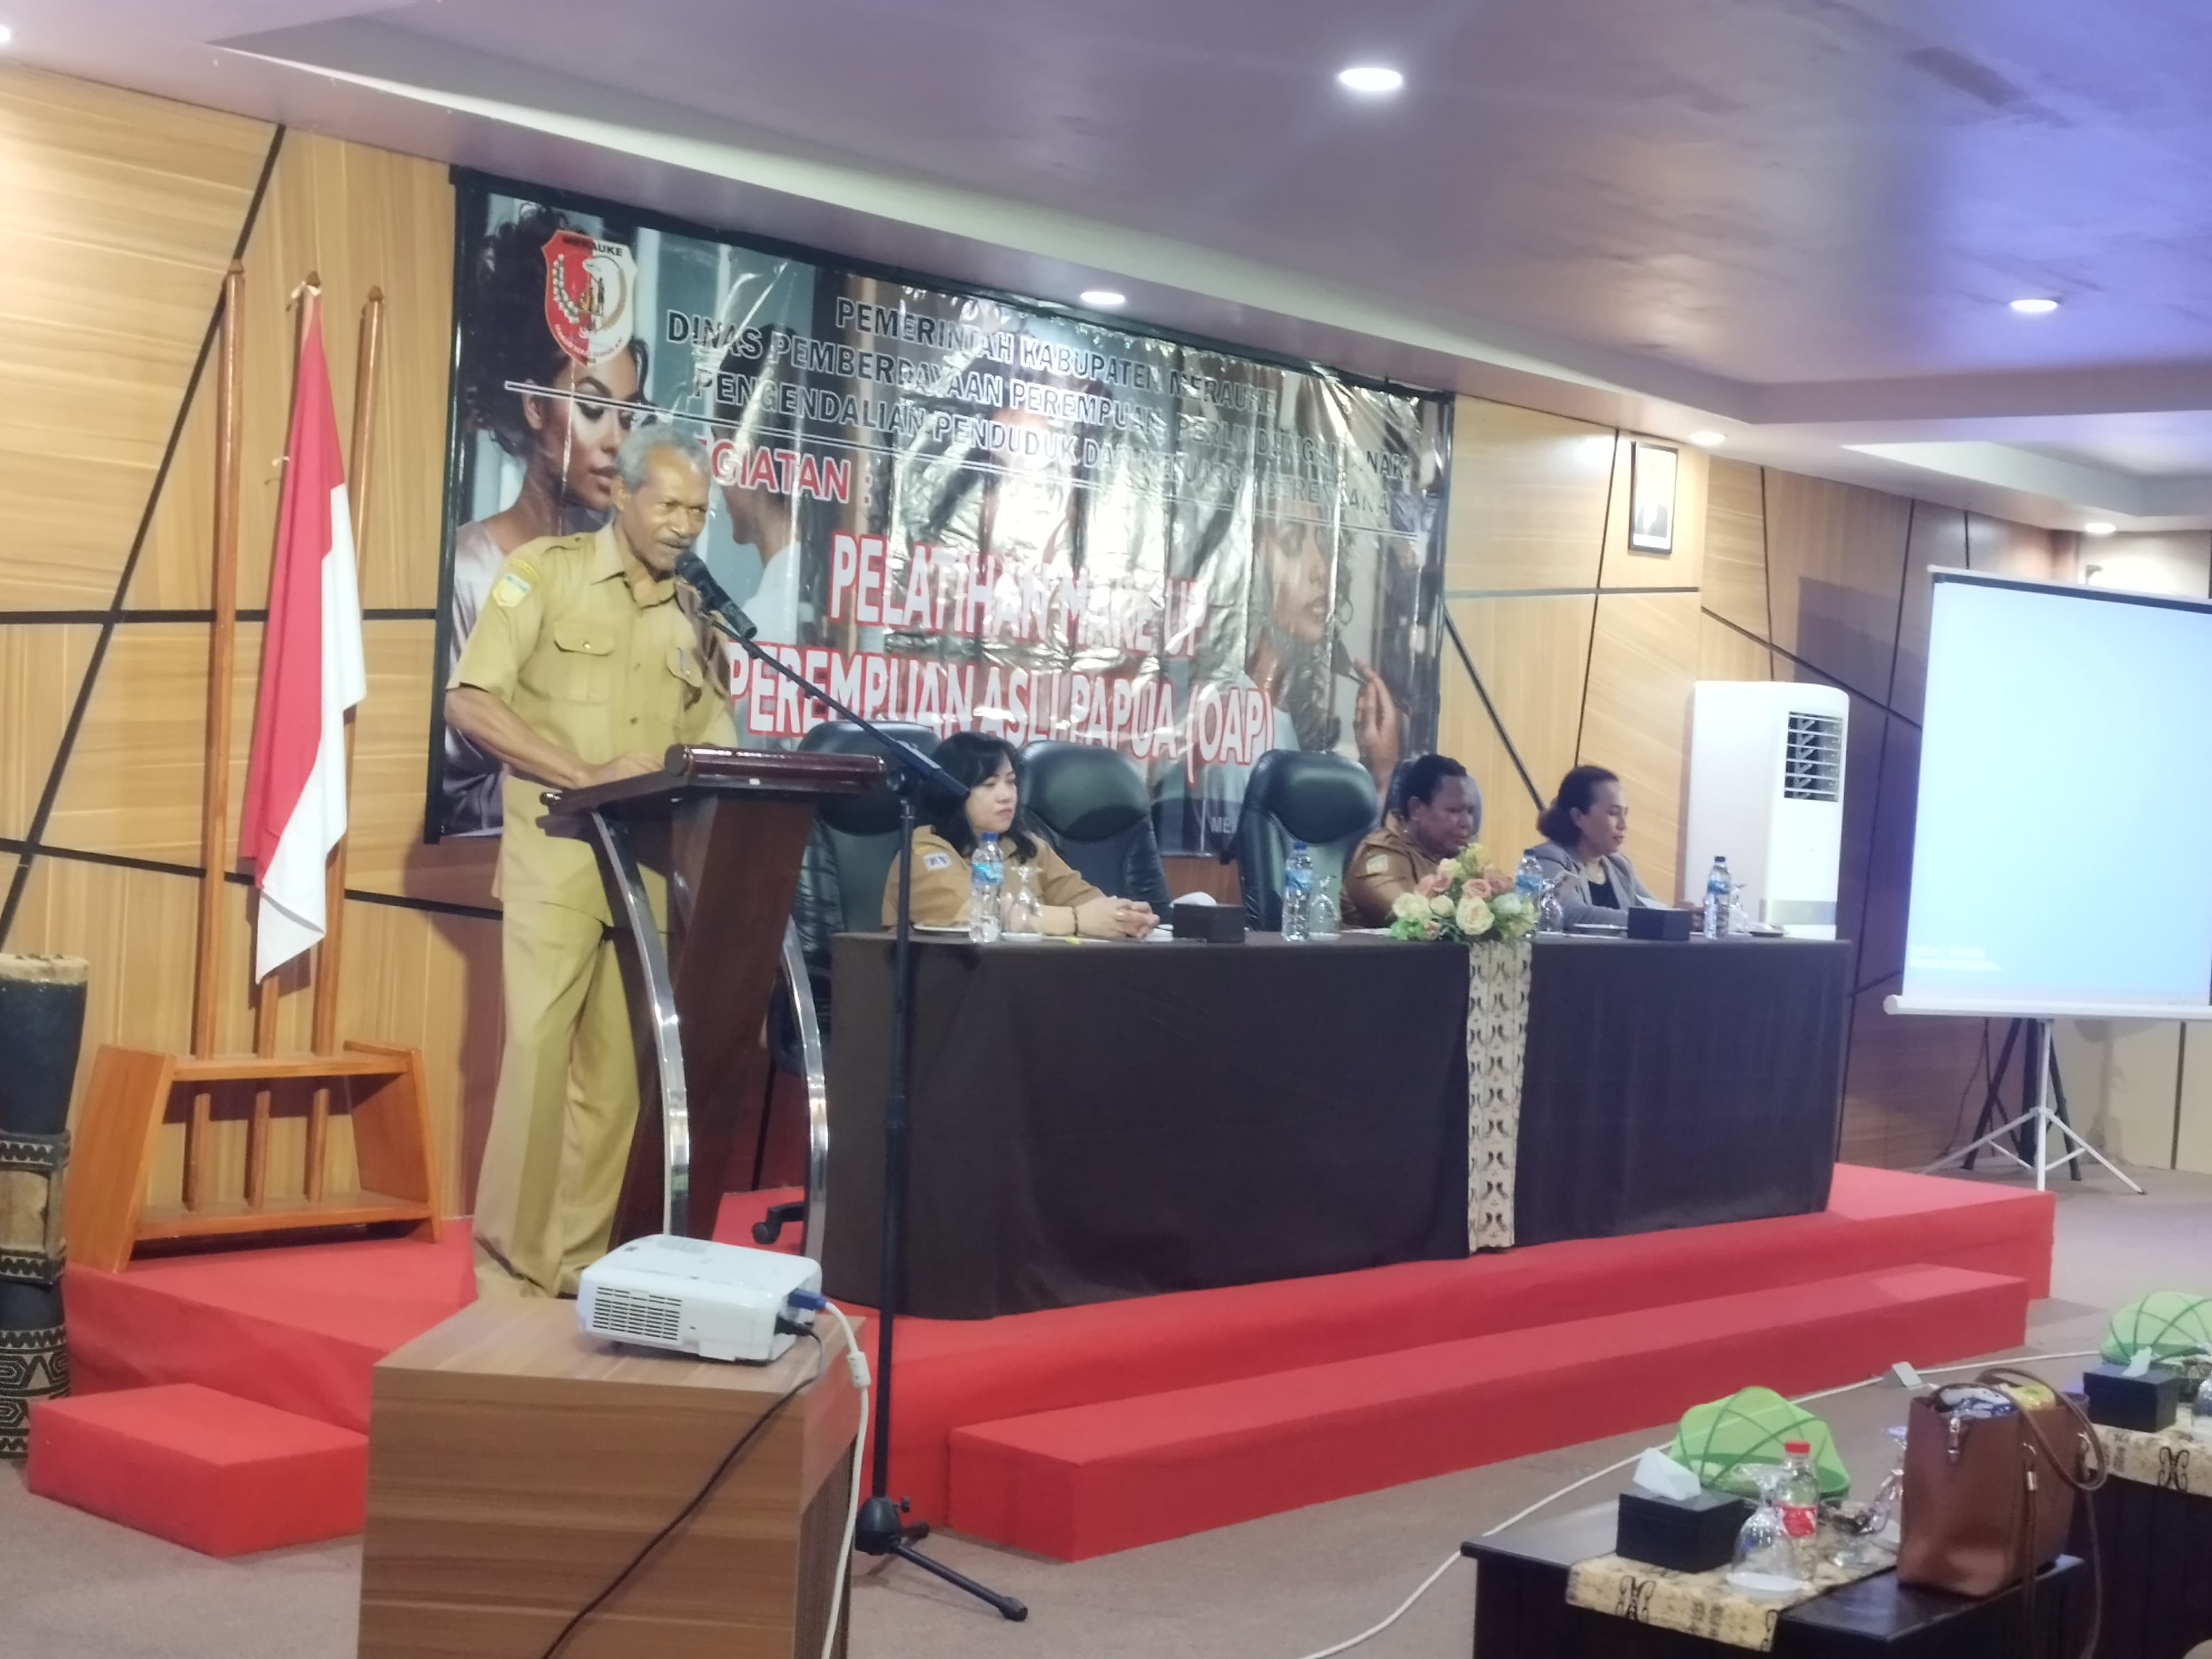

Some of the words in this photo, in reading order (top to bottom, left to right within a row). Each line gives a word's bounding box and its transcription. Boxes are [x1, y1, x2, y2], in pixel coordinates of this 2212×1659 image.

[666, 309, 763, 359] DINAS
[770, 331, 1003, 408] PEMBERDAYAAN
[836, 296, 1014, 366] PEMERINTAH
[1020, 330, 1162, 395] KABUPATEN
[693, 367, 927, 437] PENGENDALIAN
[932, 413, 1079, 469] PENDUDUK
[830, 531, 1050, 641] PELATIHAN
[729, 641, 977, 739] PEREMPUAN
[979, 666, 1063, 744] ASLI
[1068, 674, 1178, 760] PAPUA
[1185, 684, 1275, 787] (OAP)
